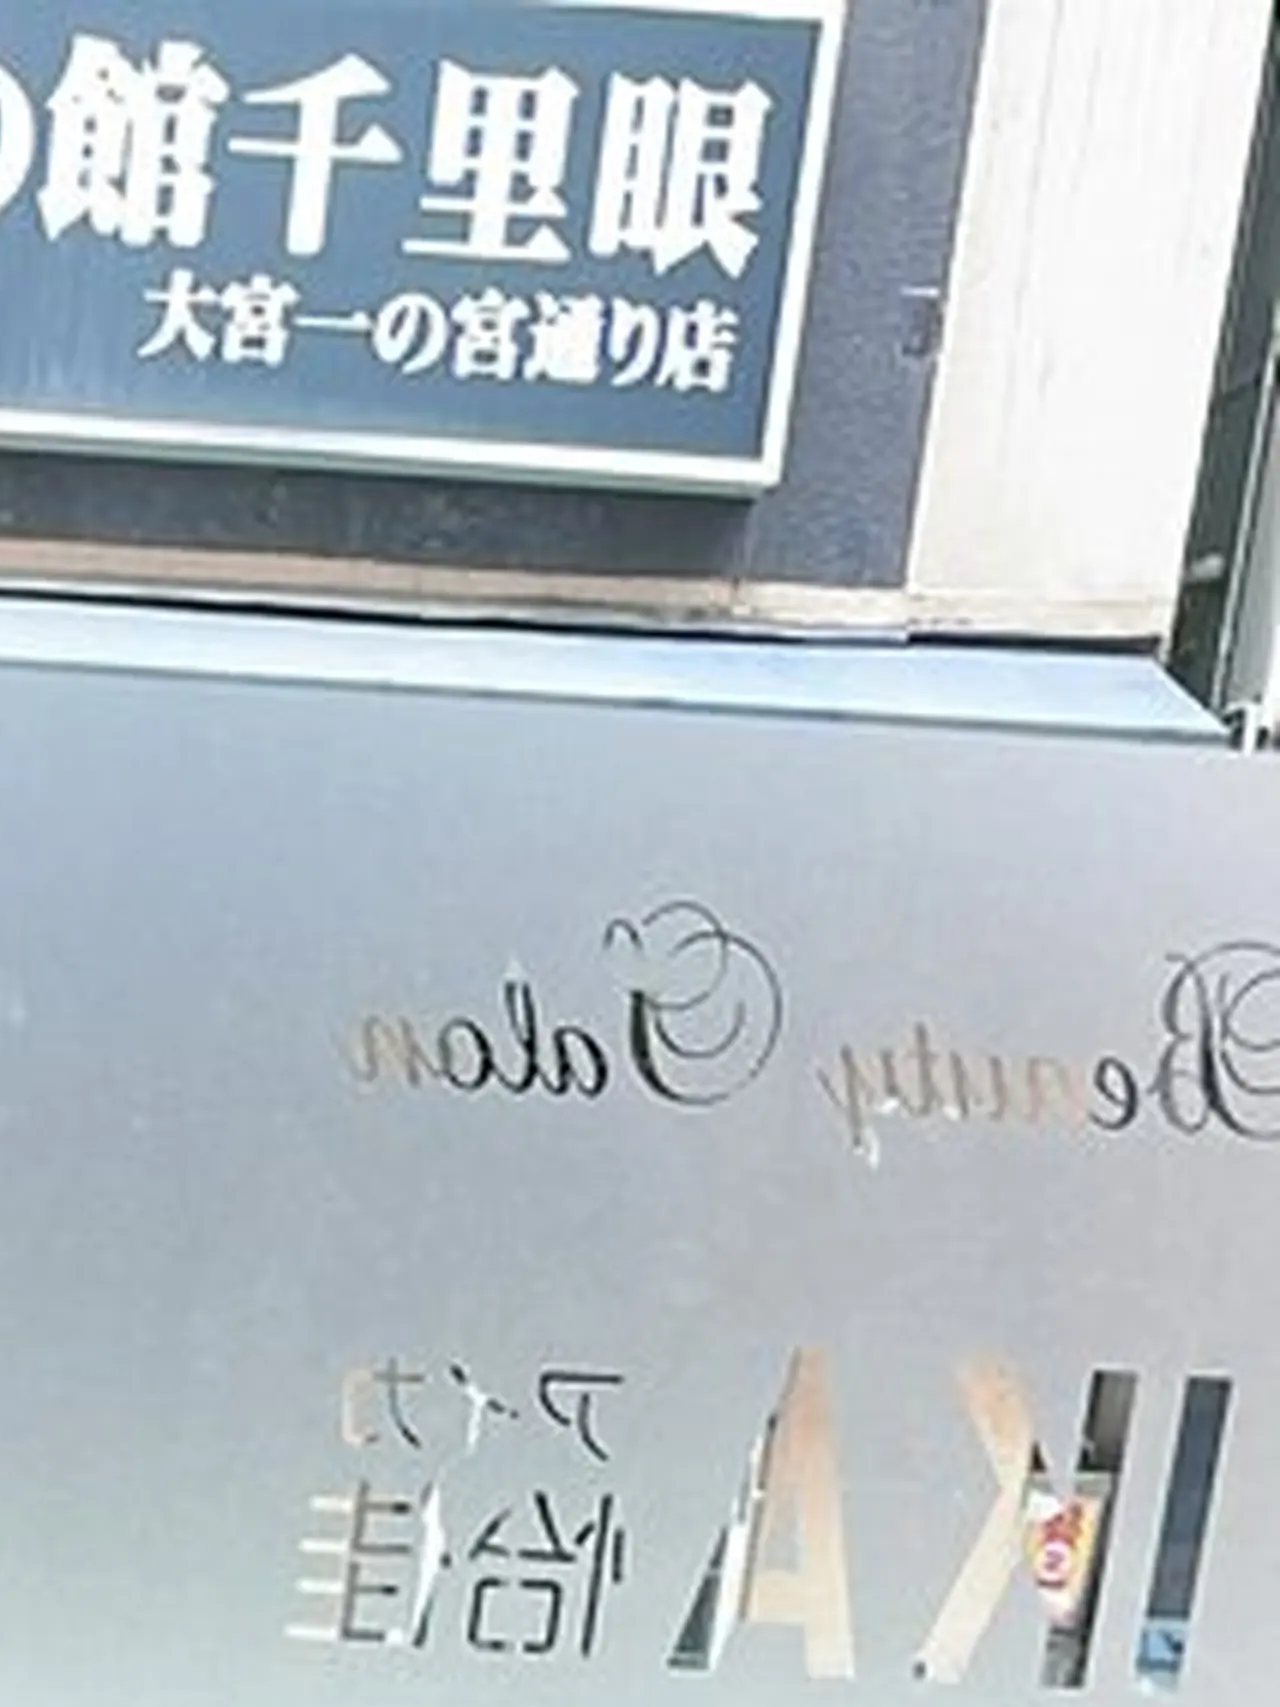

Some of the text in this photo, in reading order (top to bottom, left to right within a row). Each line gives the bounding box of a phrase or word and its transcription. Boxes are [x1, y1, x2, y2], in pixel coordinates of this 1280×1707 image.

[136, 269, 739, 393] 大宮一の宮通り店
